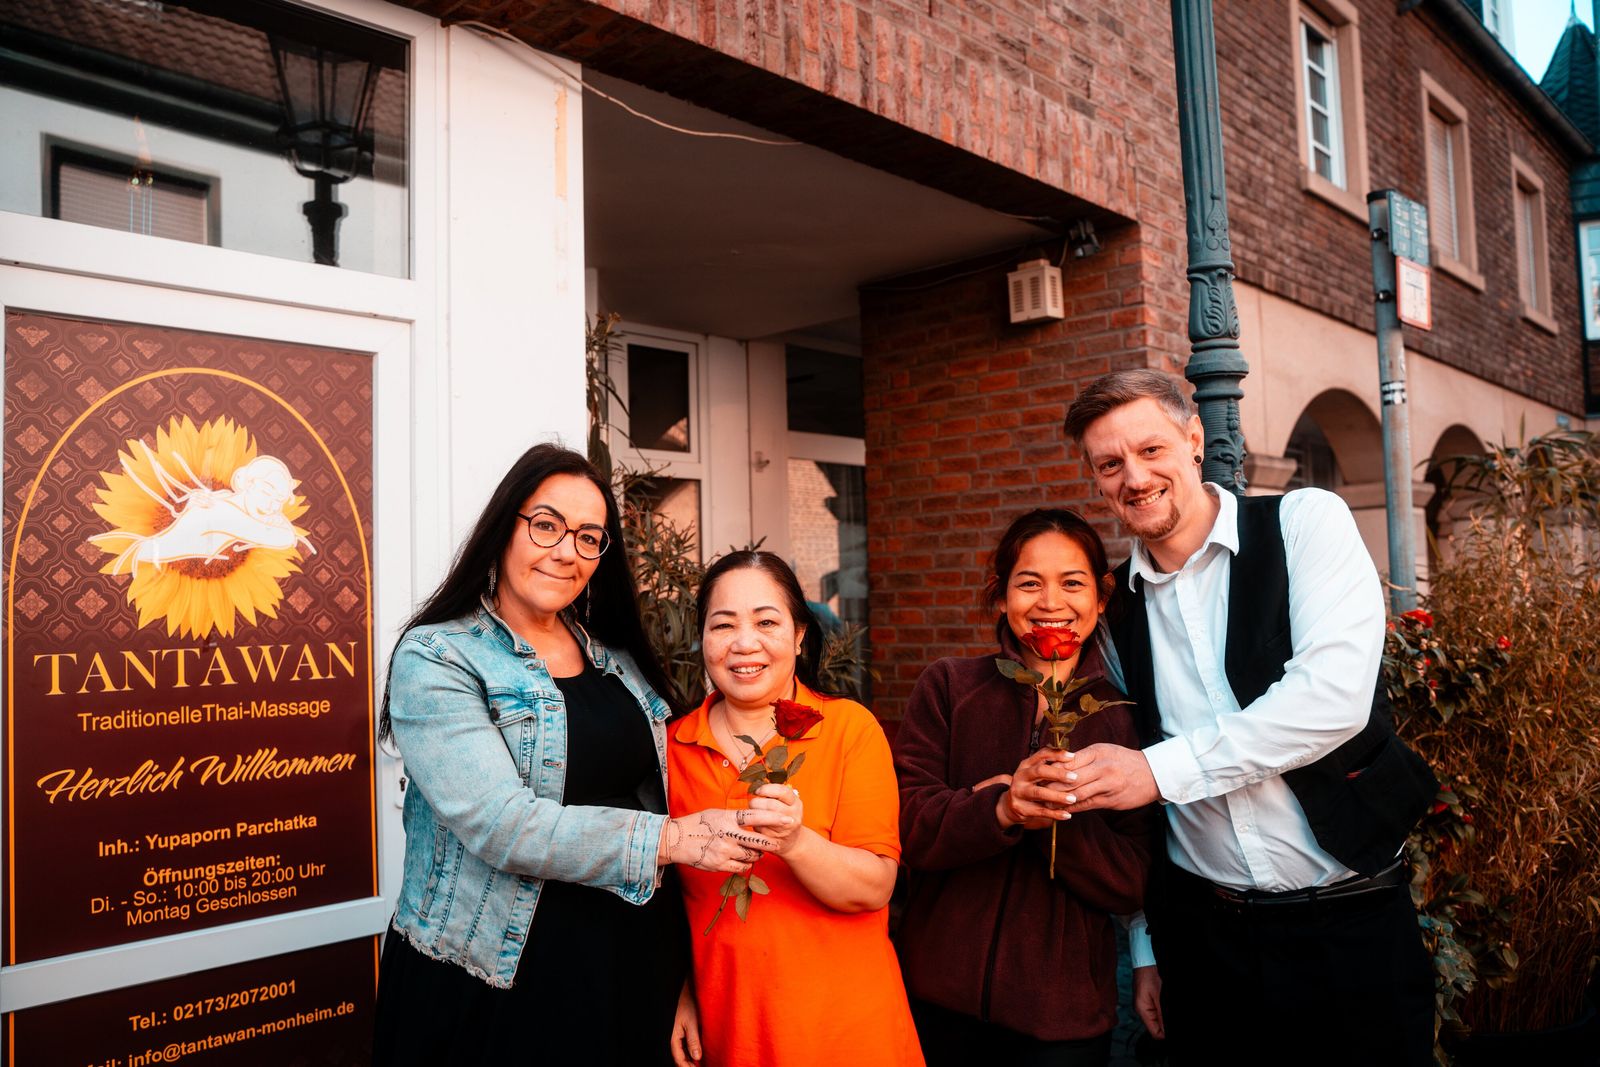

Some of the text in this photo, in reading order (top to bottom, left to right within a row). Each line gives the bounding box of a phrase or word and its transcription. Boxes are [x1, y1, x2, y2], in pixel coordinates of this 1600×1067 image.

[33, 641, 358, 696] TANTAWAN
[36, 747, 357, 804] Herzlich Willkommen
[98, 814, 318, 857] Inh.: Yupaporn Parchatka
[91, 897, 115, 914] Di.
[133, 889, 167, 907] So.:
[174, 877, 219, 899] 10:00
[224, 876, 247, 891] bis
[251, 866, 295, 887] 20:00
[299, 862, 326, 879] Uhr
[143, 853, 281, 887] Öffnungszeiten:
[126, 885, 297, 926] Montag Geschlossen
[129, 979, 296, 1032] Tel.: 02173/2072001
[128, 1001, 355, 1067] info@tantawan-monheim.de
